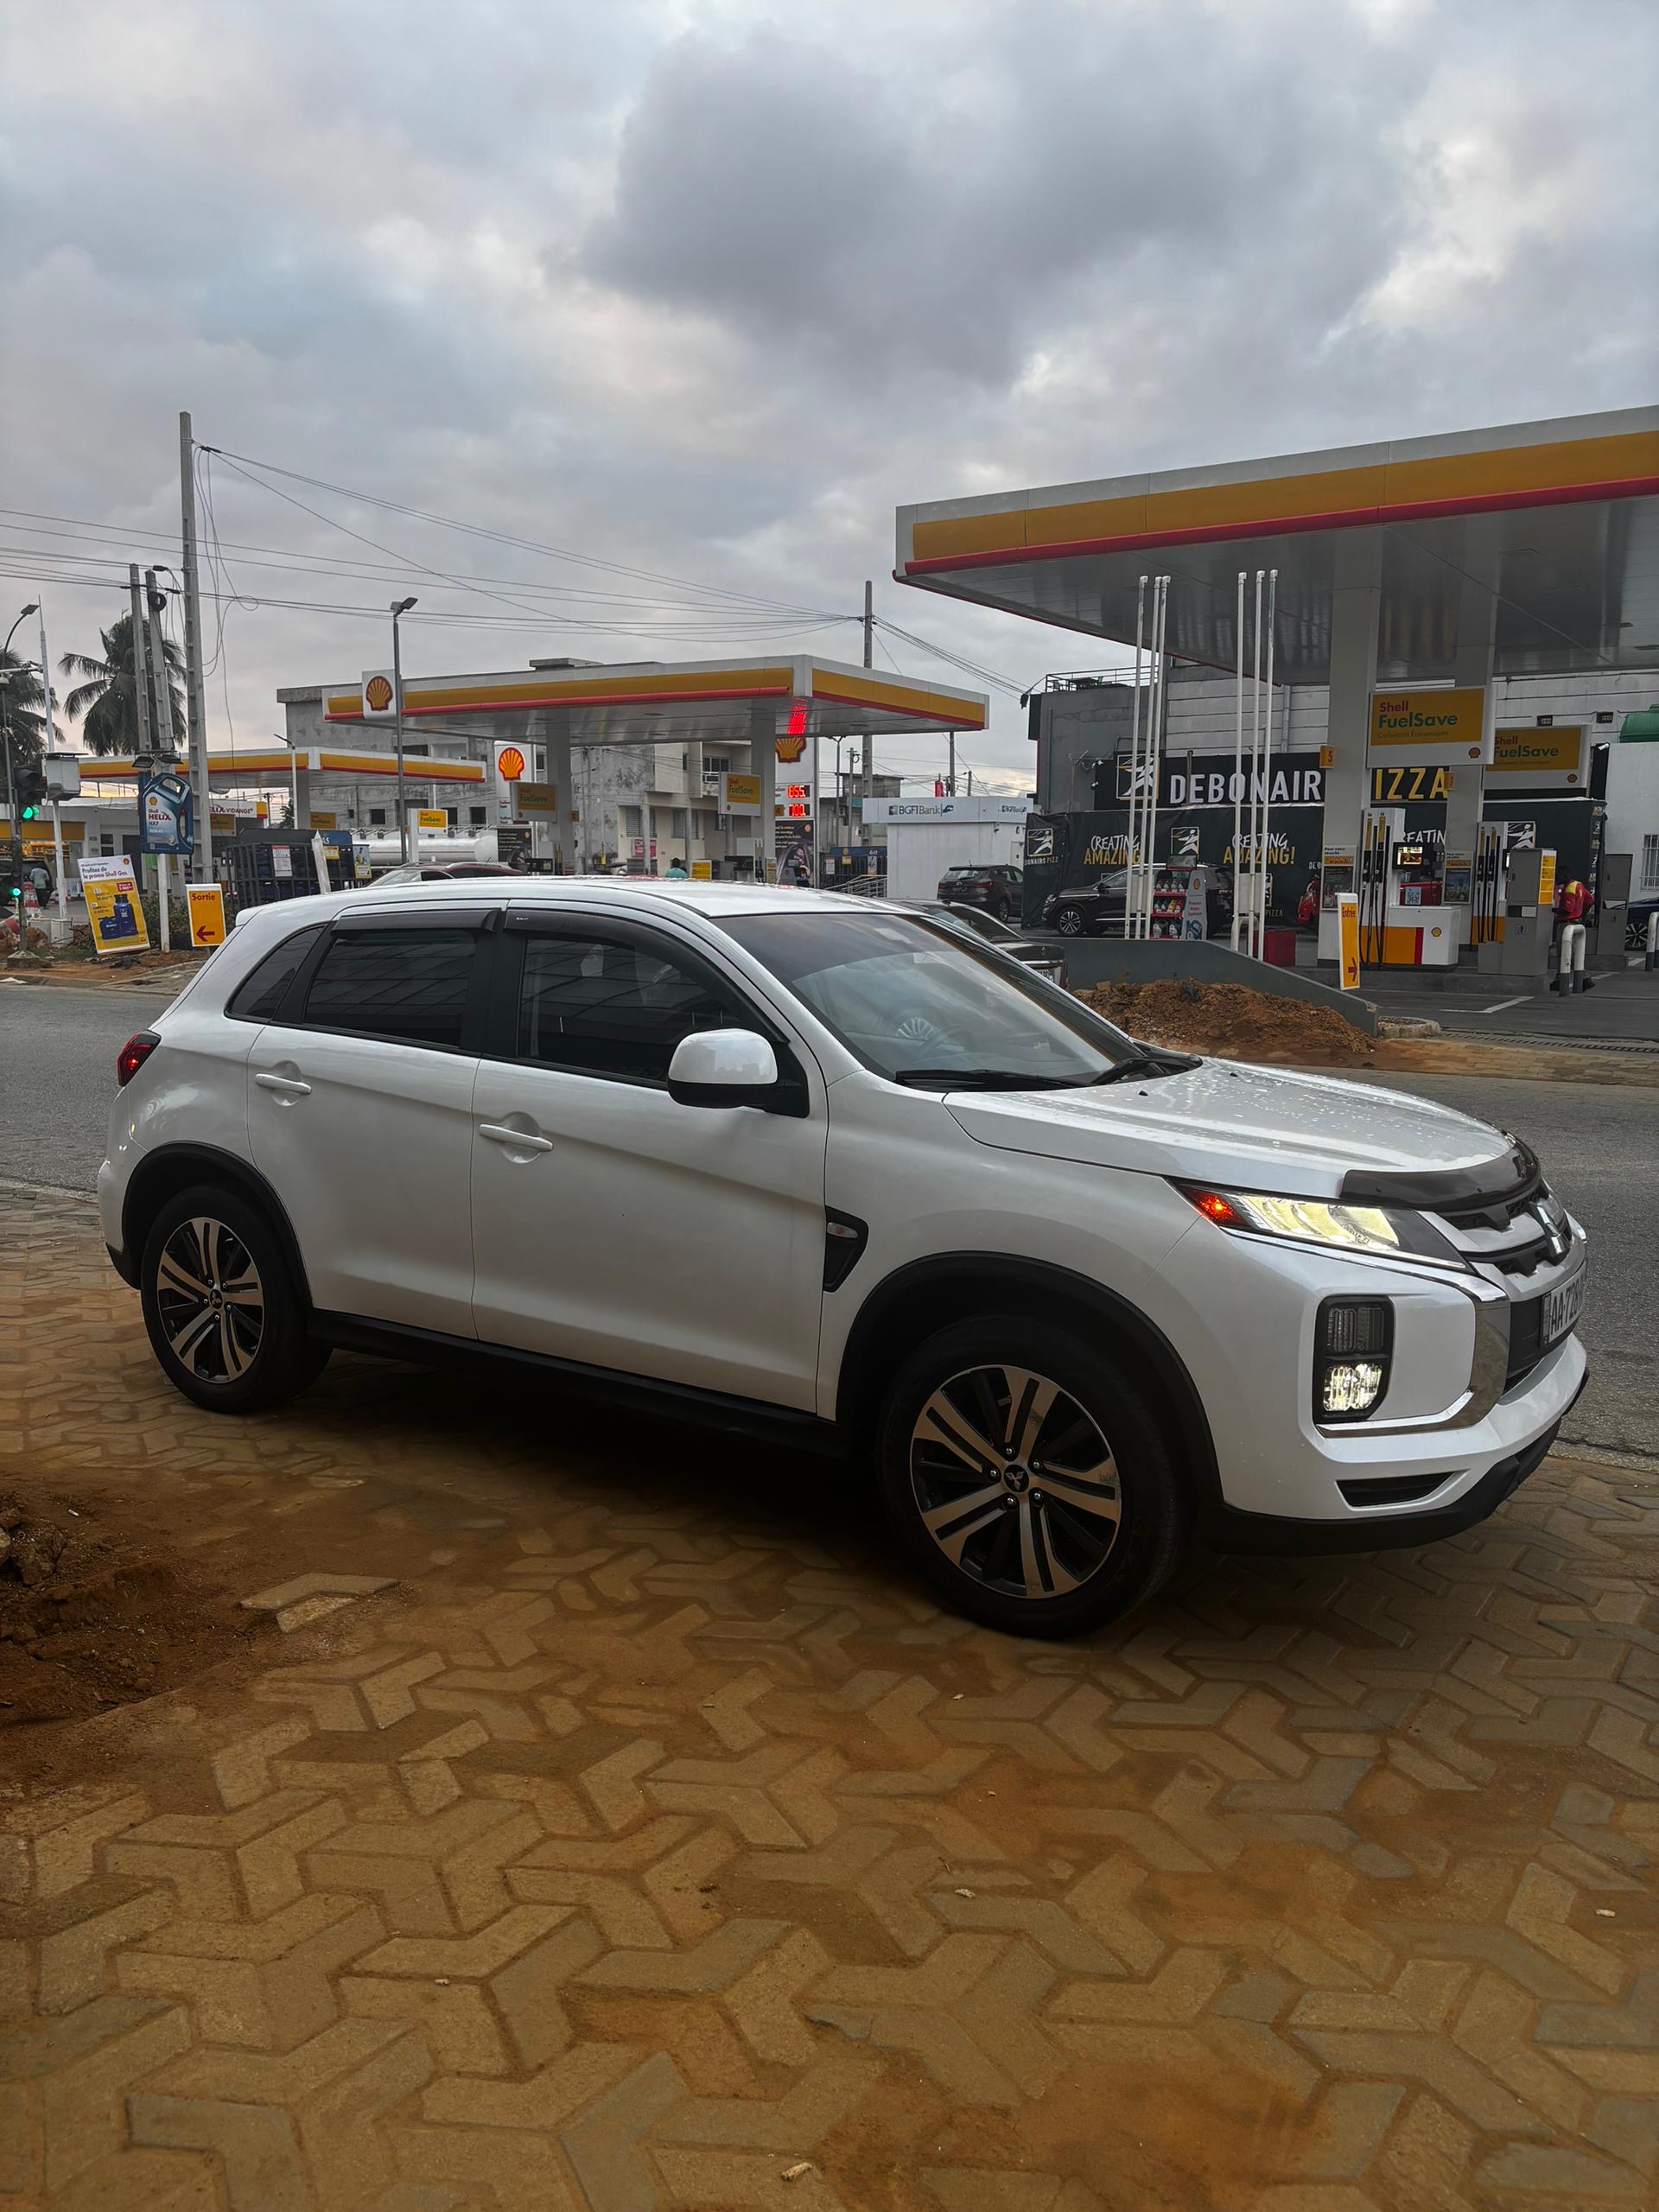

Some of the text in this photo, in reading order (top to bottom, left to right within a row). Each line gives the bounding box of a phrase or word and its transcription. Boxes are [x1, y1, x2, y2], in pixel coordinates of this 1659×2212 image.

[1379, 700, 1409, 713] Shell
[1378, 711, 1459, 728] FuelSave
[1494, 735, 1518, 746] Shell
[1494, 745, 1560, 758] FuelSave
[899, 804, 941, 815] BGFIBank
[149, 812, 171, 821] HELIX
[1090, 834, 1140, 852] CREATING
[1231, 832, 1288, 849] CRETNG
[1223, 846, 1295, 865] AAZNG!
[192, 892, 215, 901] Sortie
